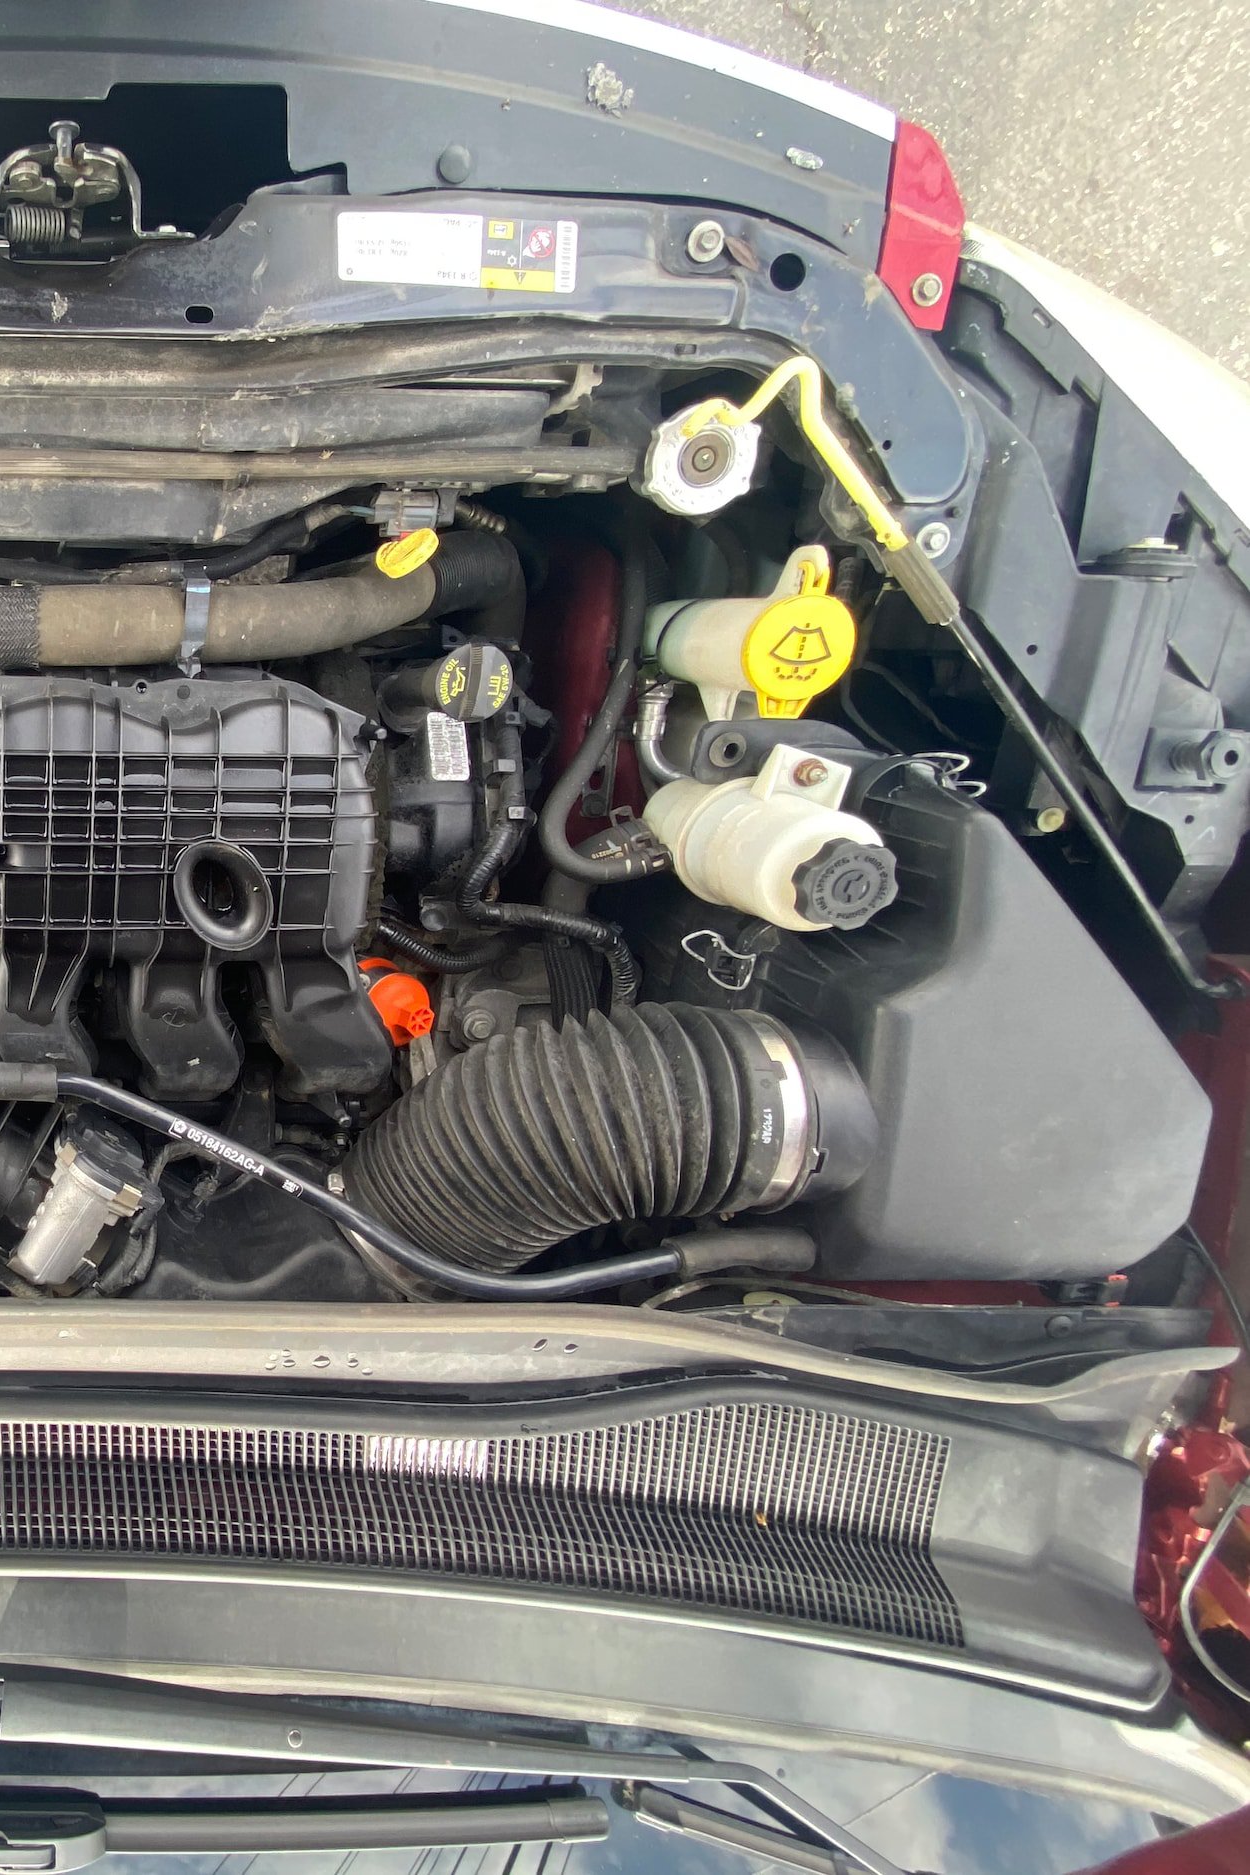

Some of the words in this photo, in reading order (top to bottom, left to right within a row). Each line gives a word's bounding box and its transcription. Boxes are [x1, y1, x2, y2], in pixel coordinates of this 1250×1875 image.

[444, 657, 460, 672] OIL
[440, 671, 452, 705] ENGINE
[492, 692, 507, 709] SAE
[187, 1128, 265, 1177] 05184162AG-A
